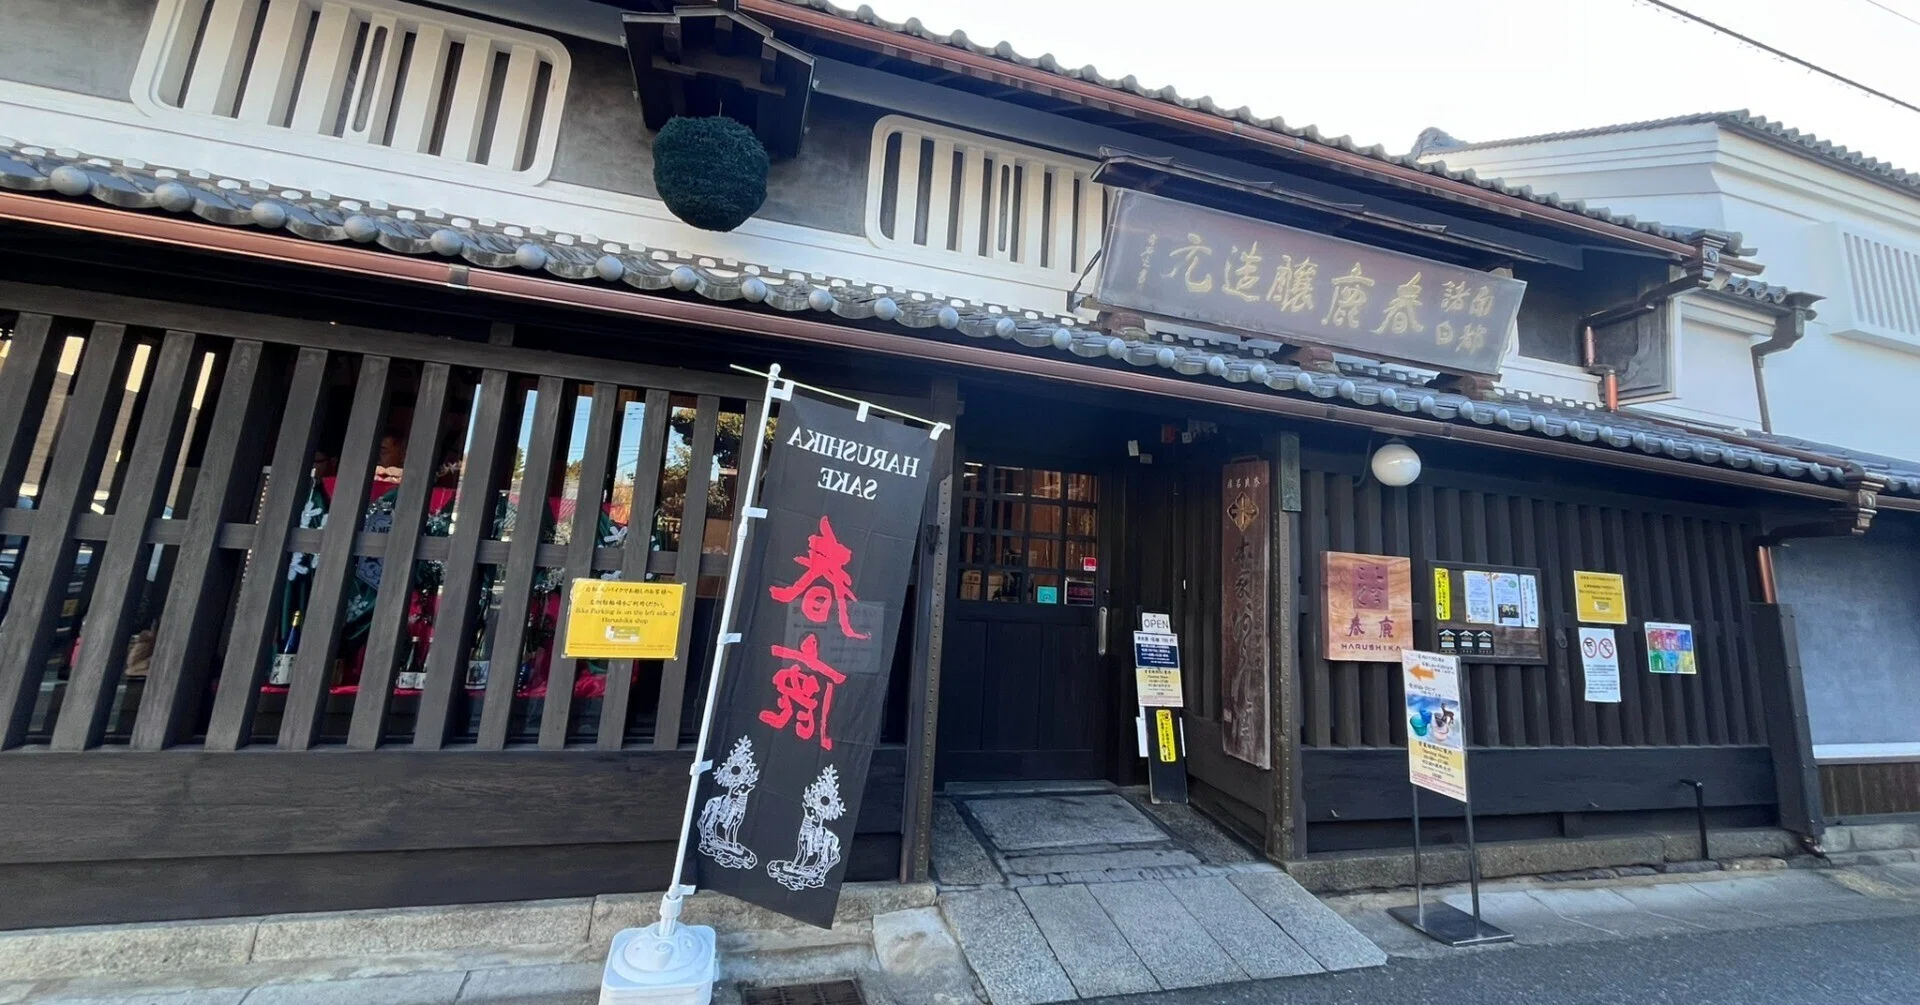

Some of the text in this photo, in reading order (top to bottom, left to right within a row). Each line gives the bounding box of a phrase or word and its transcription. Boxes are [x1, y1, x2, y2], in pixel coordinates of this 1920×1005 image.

[590, 608, 615, 616] Parking
[1144, 619, 1169, 629] OPEN
[1346, 612, 1394, 638] 春鹿
[1341, 643, 1401, 653] HARUSHIKA
